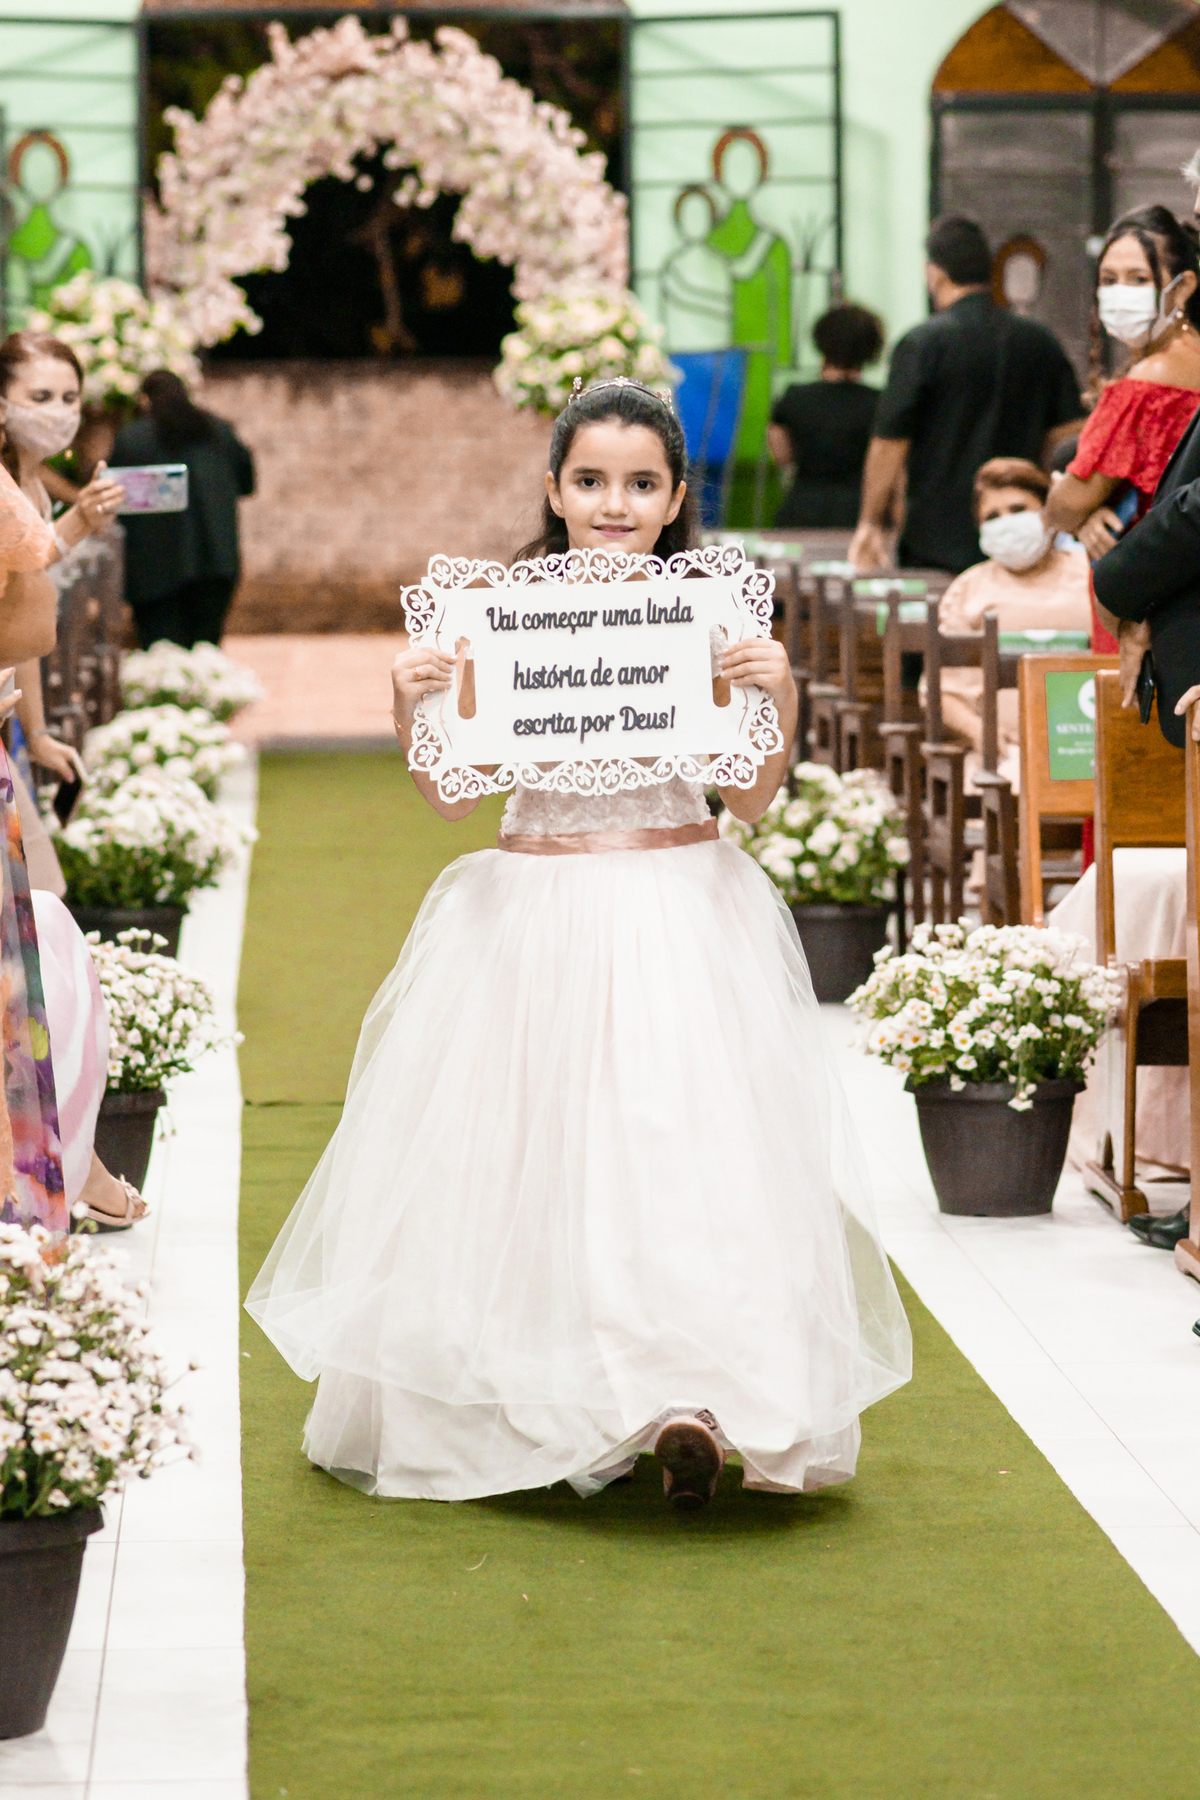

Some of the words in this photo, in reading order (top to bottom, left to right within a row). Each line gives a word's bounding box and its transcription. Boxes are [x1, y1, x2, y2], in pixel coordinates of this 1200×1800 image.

[486, 606, 520, 632] Vai
[521, 609, 599, 635] começar
[602, 607, 644, 627] uma
[646, 596, 695, 625] linda
[513, 660, 588, 691] história
[590, 656, 615, 687] de
[617, 664, 670, 686] amor
[512, 712, 578, 736] escrita
[580, 714, 616, 744] por
[619, 705, 677, 732] Deus!
